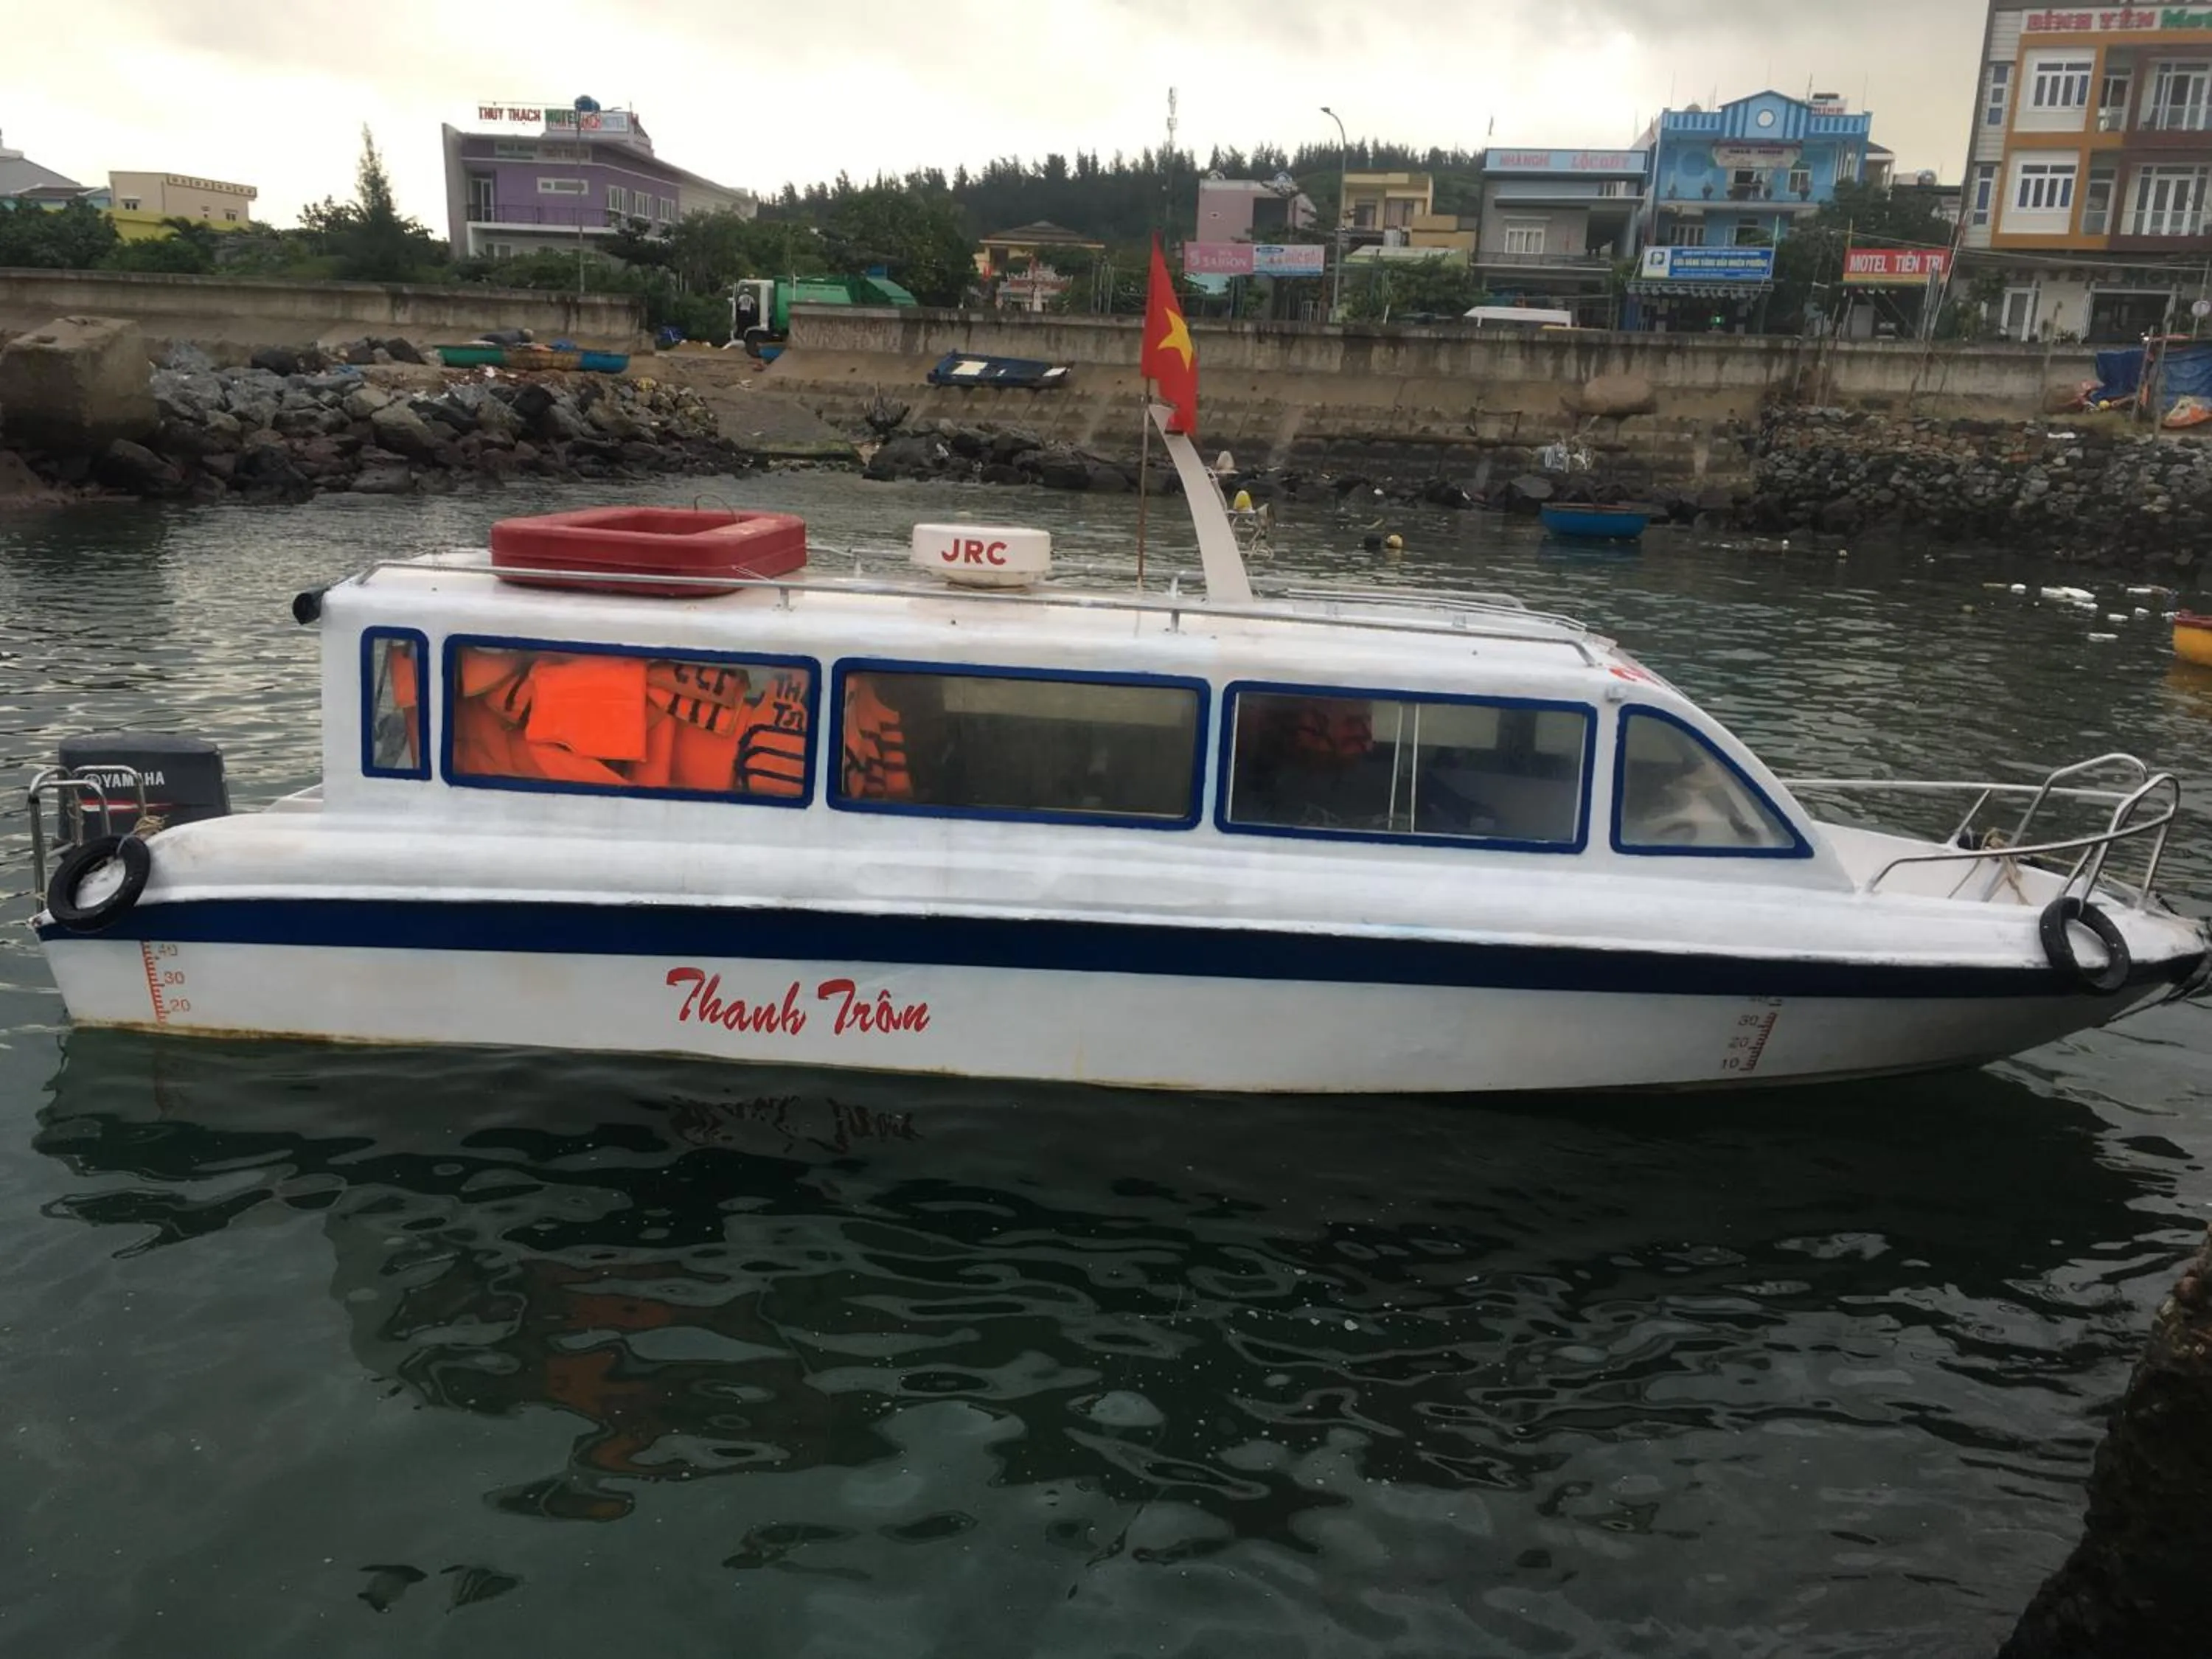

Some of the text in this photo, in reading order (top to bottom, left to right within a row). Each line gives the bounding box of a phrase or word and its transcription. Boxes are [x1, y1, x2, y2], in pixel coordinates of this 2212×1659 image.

[1848, 254, 1888, 272] MOTEL
[941, 538, 1008, 566] JRC
[164, 970, 185, 985] 30
[170, 998, 191, 1012] 20
[666, 967, 806, 1035] Thanh
[1738, 1015, 1759, 1026] 30
[1722, 1057, 1739, 1069] 10
